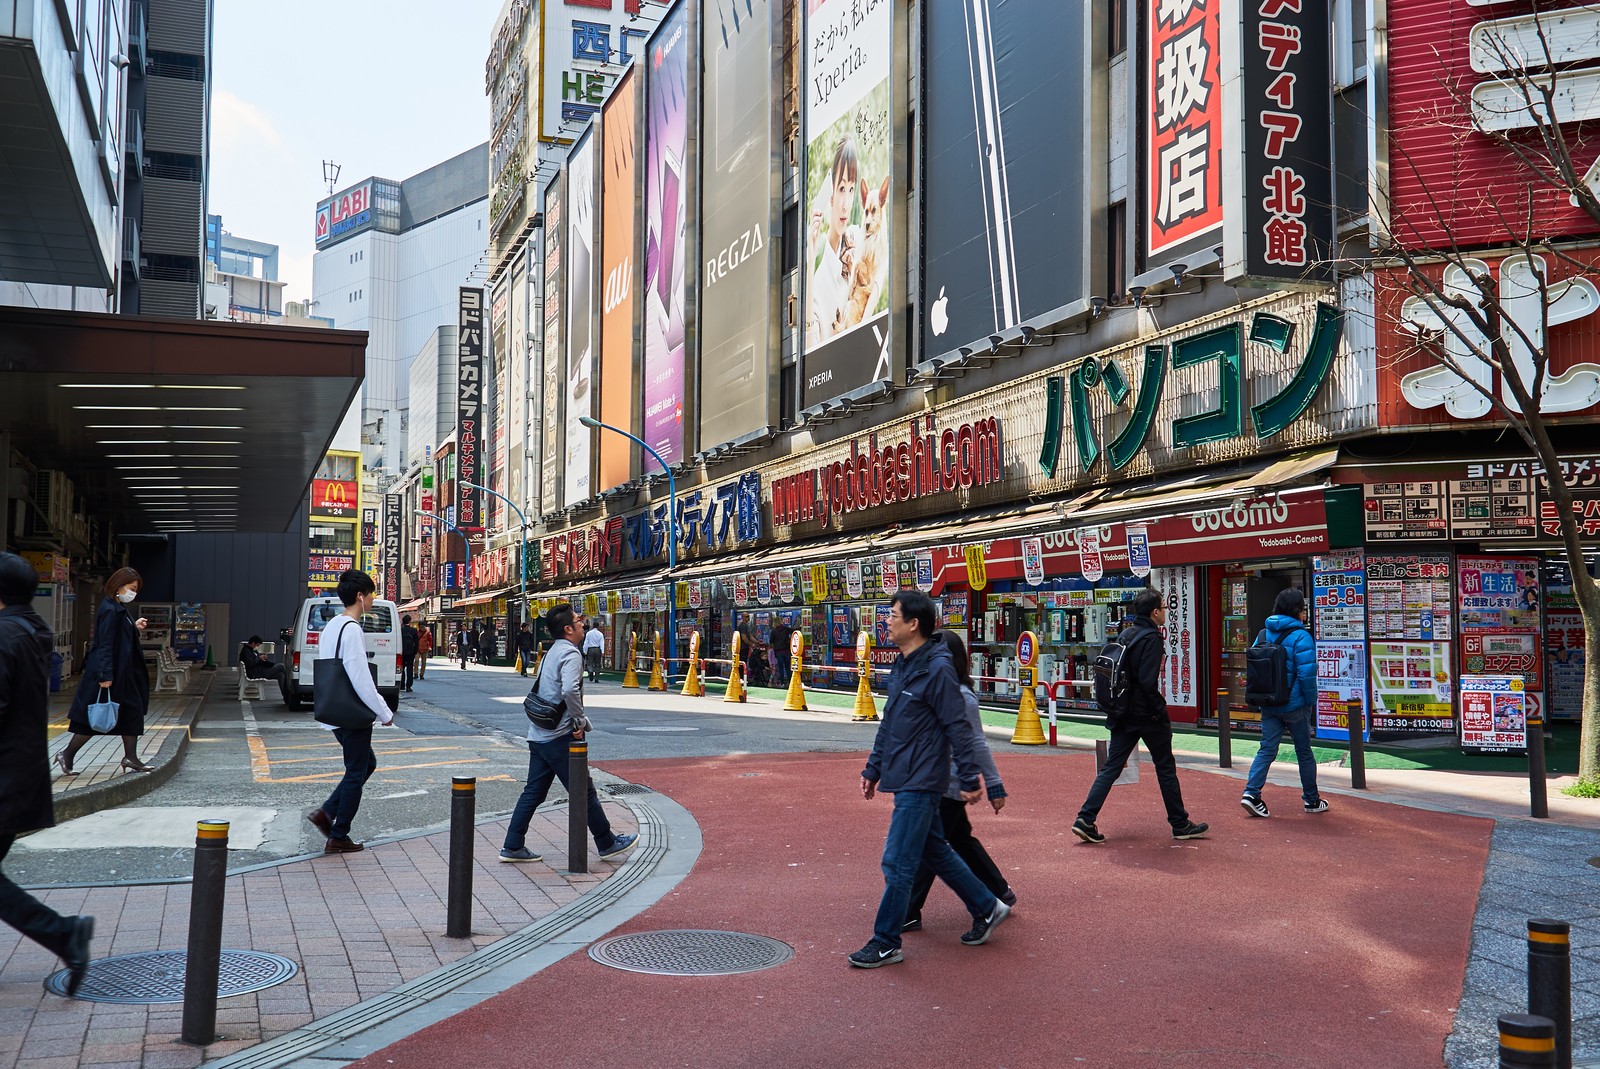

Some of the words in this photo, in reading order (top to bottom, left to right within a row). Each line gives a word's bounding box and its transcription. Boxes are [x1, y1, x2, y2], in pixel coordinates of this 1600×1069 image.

[664, 25, 682, 58] HUAWEI
[331, 186, 368, 224] LABI
[707, 223, 763, 288] REGZA
[605, 256, 632, 315] au
[460, 291, 480, 416] ヨドバシカメラ
[808, 369, 833, 390] XPERIA
[1040, 300, 1344, 479] パソコン
[771, 414, 1003, 529] www.yodobashi.com
[333, 508, 343, 516] 24
[386, 495, 399, 566] ヨドバシカメラ
[1081, 543, 1098, 553] 8%
[1258, 534, 1324, 548] Yodobashi-Camera
[1083, 559, 1099, 571] 5%
[1367, 563, 1450, 578] 各館のご案内
[1464, 572, 1515, 592] 新生活
[1317, 649, 1347, 659] まとめ買い
[1484, 654, 1537, 671] エアコン
[1318, 660, 1339, 678] 割引
[1401, 703, 1425, 712] 新宿駅
[1469, 704, 1485, 712] 最新
[1418, 719, 1441, 727] 10:00
[1465, 733, 1524, 743] 無料にて配布中
